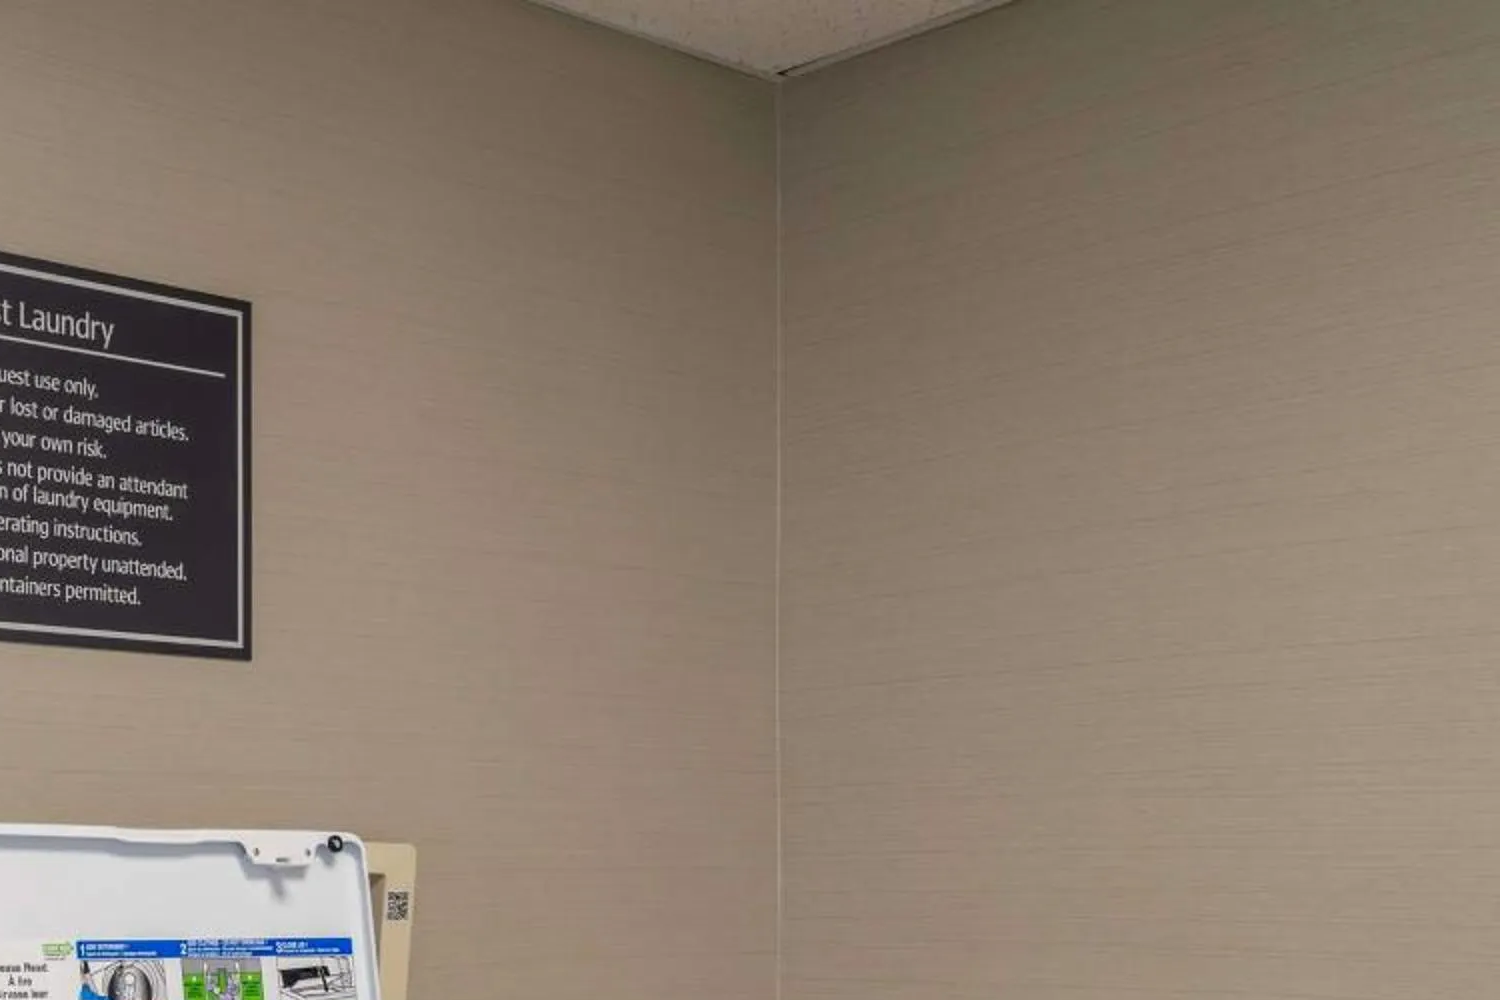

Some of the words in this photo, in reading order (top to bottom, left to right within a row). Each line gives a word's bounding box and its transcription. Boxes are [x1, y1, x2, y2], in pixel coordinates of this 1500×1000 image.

[20, 302, 114, 348] Laundry
[34, 376, 60, 391] use
[64, 378, 98, 400] only.
[11, 396, 38, 418] lost
[43, 406, 58, 420] or
[64, 406, 130, 433] damaged
[136, 420, 188, 440] articles.
[2, 430, 36, 448] your
[41, 436, 72, 453] own
[78, 438, 106, 458] risk.
[8, 462, 33, 478] not
[38, 466, 92, 486] provide
[98, 474, 114, 488] an
[120, 476, 188, 500] attendant
[12, 484, 29, 502] of
[34, 486, 88, 512] laundry
[94, 497, 172, 520] equipment.
[54, 523, 142, 546] instructions.
[33, 551, 98, 574] property
[102, 560, 186, 580] unattended.
[66, 584, 140, 604] permitted.
